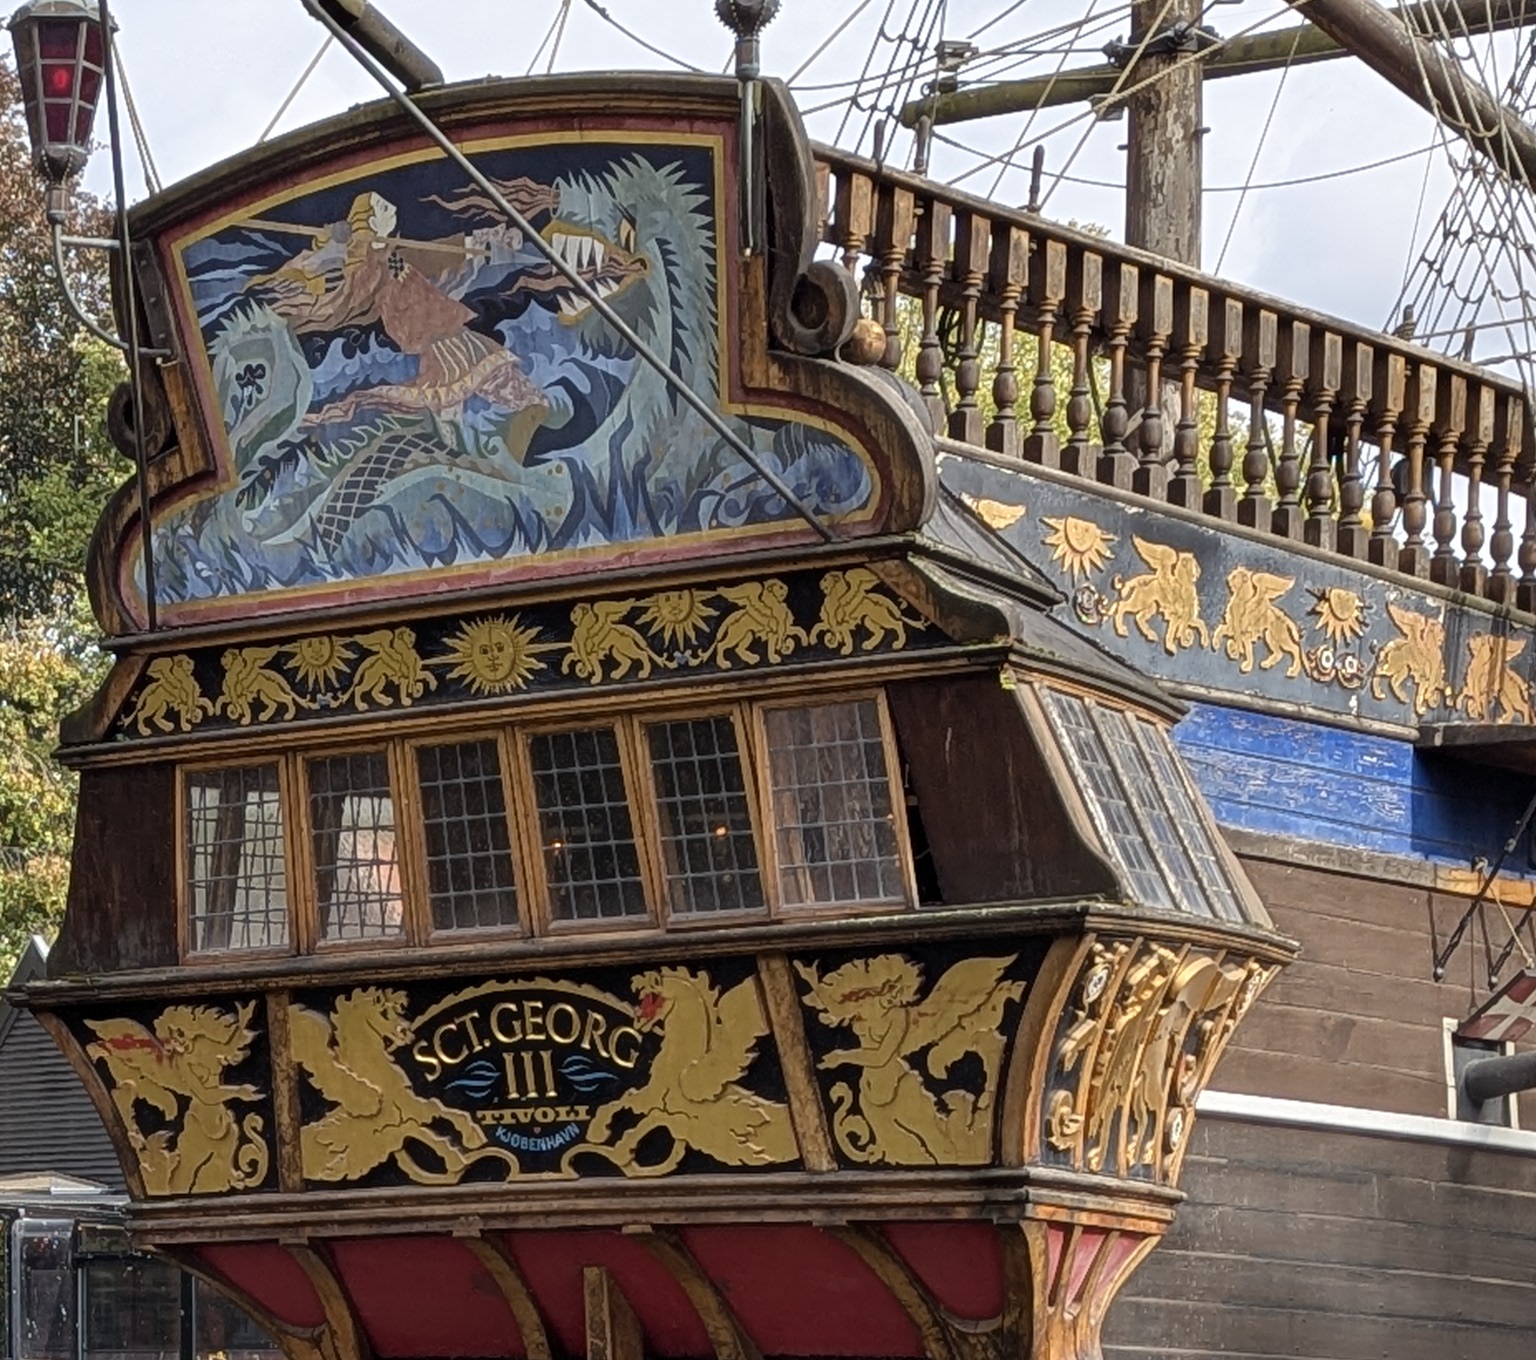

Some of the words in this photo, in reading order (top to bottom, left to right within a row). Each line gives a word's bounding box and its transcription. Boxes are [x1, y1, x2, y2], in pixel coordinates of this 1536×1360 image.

[414, 1011, 490, 1082] SCT.
[490, 1000, 642, 1068] GEORG
[503, 1051, 558, 1099] III
[476, 1105, 591, 1126] TIVOLI
